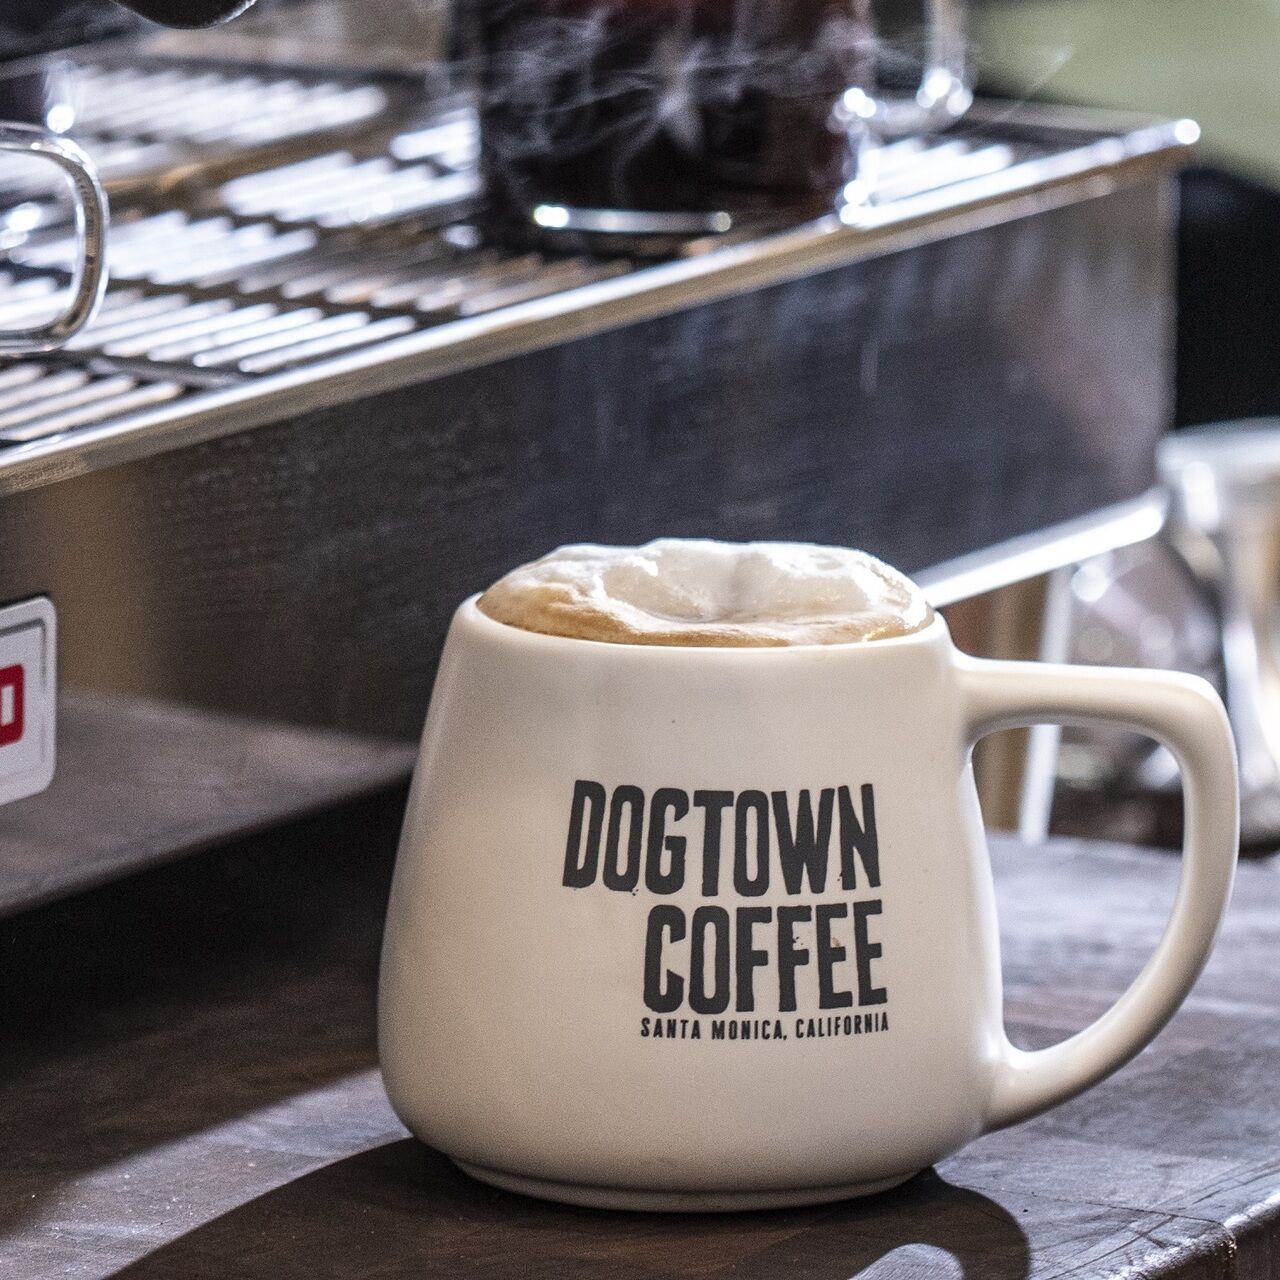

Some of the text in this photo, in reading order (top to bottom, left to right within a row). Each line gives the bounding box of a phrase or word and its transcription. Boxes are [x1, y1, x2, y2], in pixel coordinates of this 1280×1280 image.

[562, 779, 881, 897] DOGTOWN
[643, 899, 888, 1015] COFFEE
[641, 1012, 889, 1041] SANTA MONICA, CALIFORNIA
